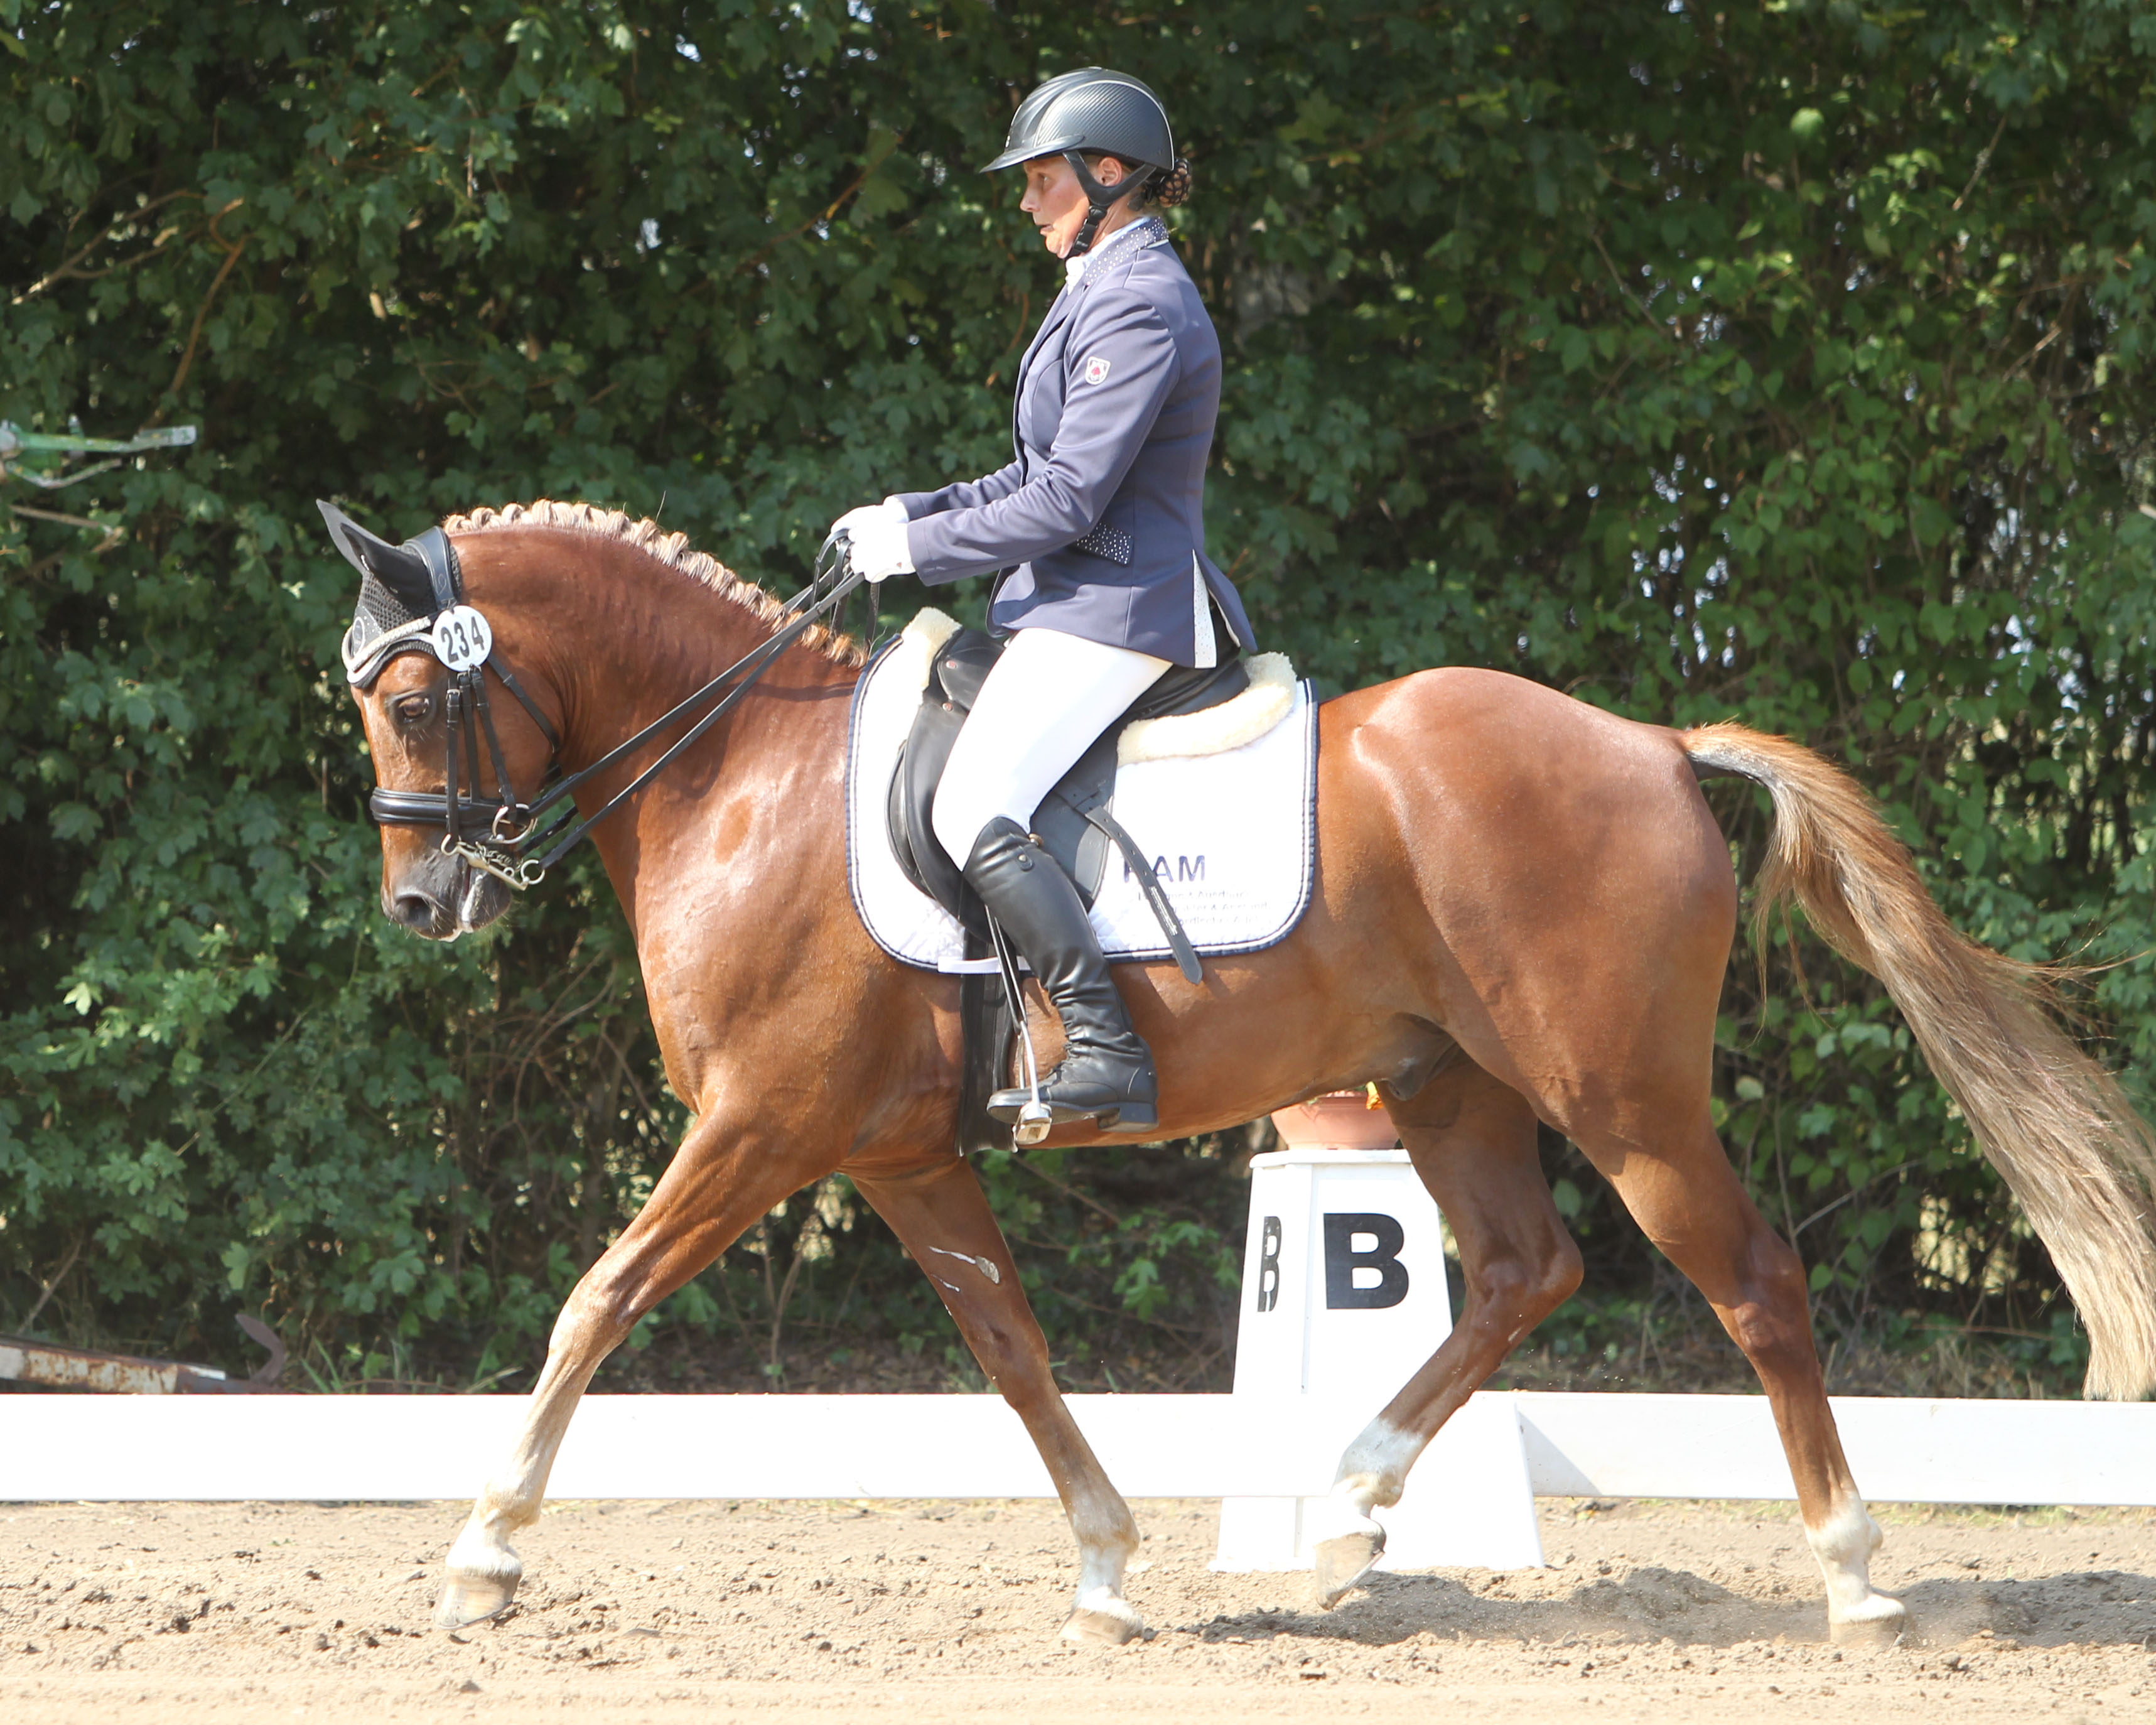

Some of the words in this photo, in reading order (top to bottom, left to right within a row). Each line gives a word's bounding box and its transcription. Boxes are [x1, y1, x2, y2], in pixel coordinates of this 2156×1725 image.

[440, 616, 485, 664] 234
[1258, 1216, 1282, 1312] B
[1323, 1213, 1409, 1310] B
